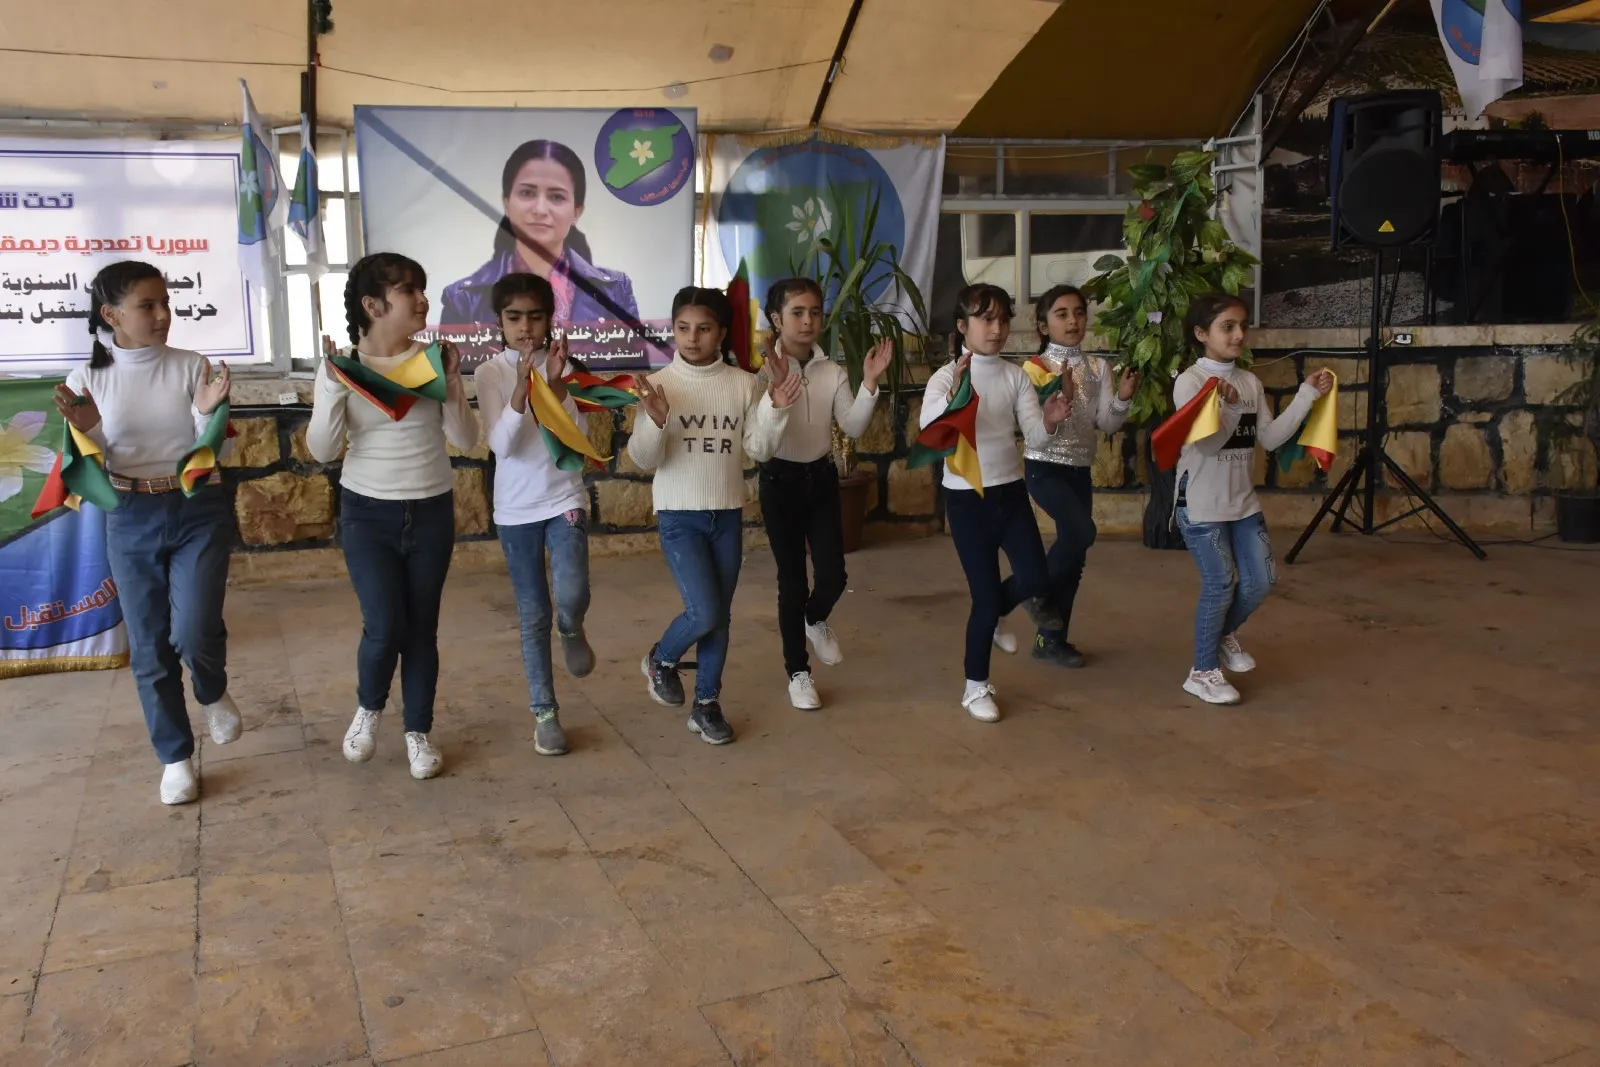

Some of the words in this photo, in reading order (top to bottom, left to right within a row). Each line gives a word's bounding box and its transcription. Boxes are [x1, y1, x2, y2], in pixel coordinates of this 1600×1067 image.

[23, 192, 74, 209] تحت
[0, 235, 60, 256] ديمق
[64, 235, 142, 256] تعددية
[147, 235, 209, 256] سوريا
[2, 272, 77, 296] السنوية
[164, 271, 202, 295] إحيا
[30, 301, 93, 324] ستقبل
[175, 303, 218, 321] حزب
[566, 325, 592, 340] خلف
[593, 324, 626, 344] هفرين
[589, 347, 644, 361] استشهدت
[679, 414, 740, 431] WIN
[683, 437, 733, 454] TER
[4, 577, 117, 631] المستقبل
